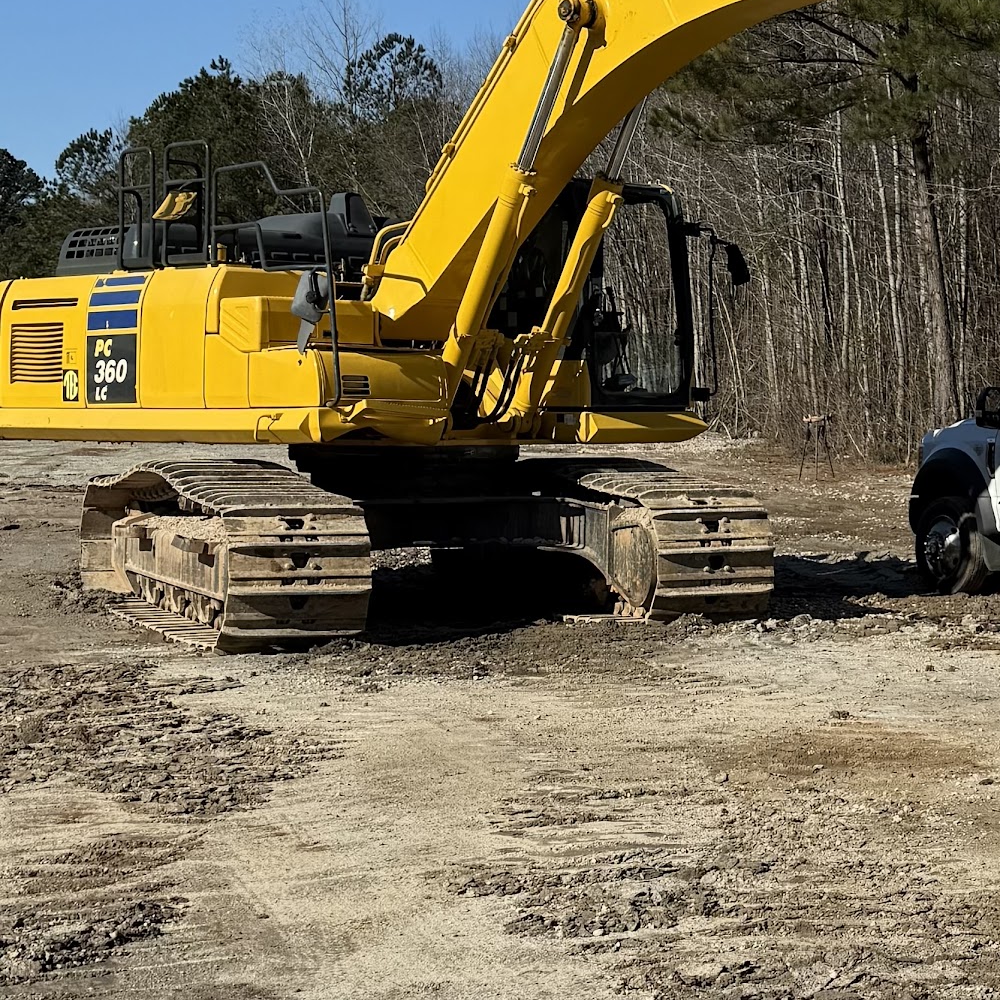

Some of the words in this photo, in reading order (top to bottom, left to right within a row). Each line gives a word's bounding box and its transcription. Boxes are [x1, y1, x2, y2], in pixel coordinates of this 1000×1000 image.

[94, 339, 112, 357] PC
[94, 359, 127, 383] 360
[95, 385, 107, 400] LC
